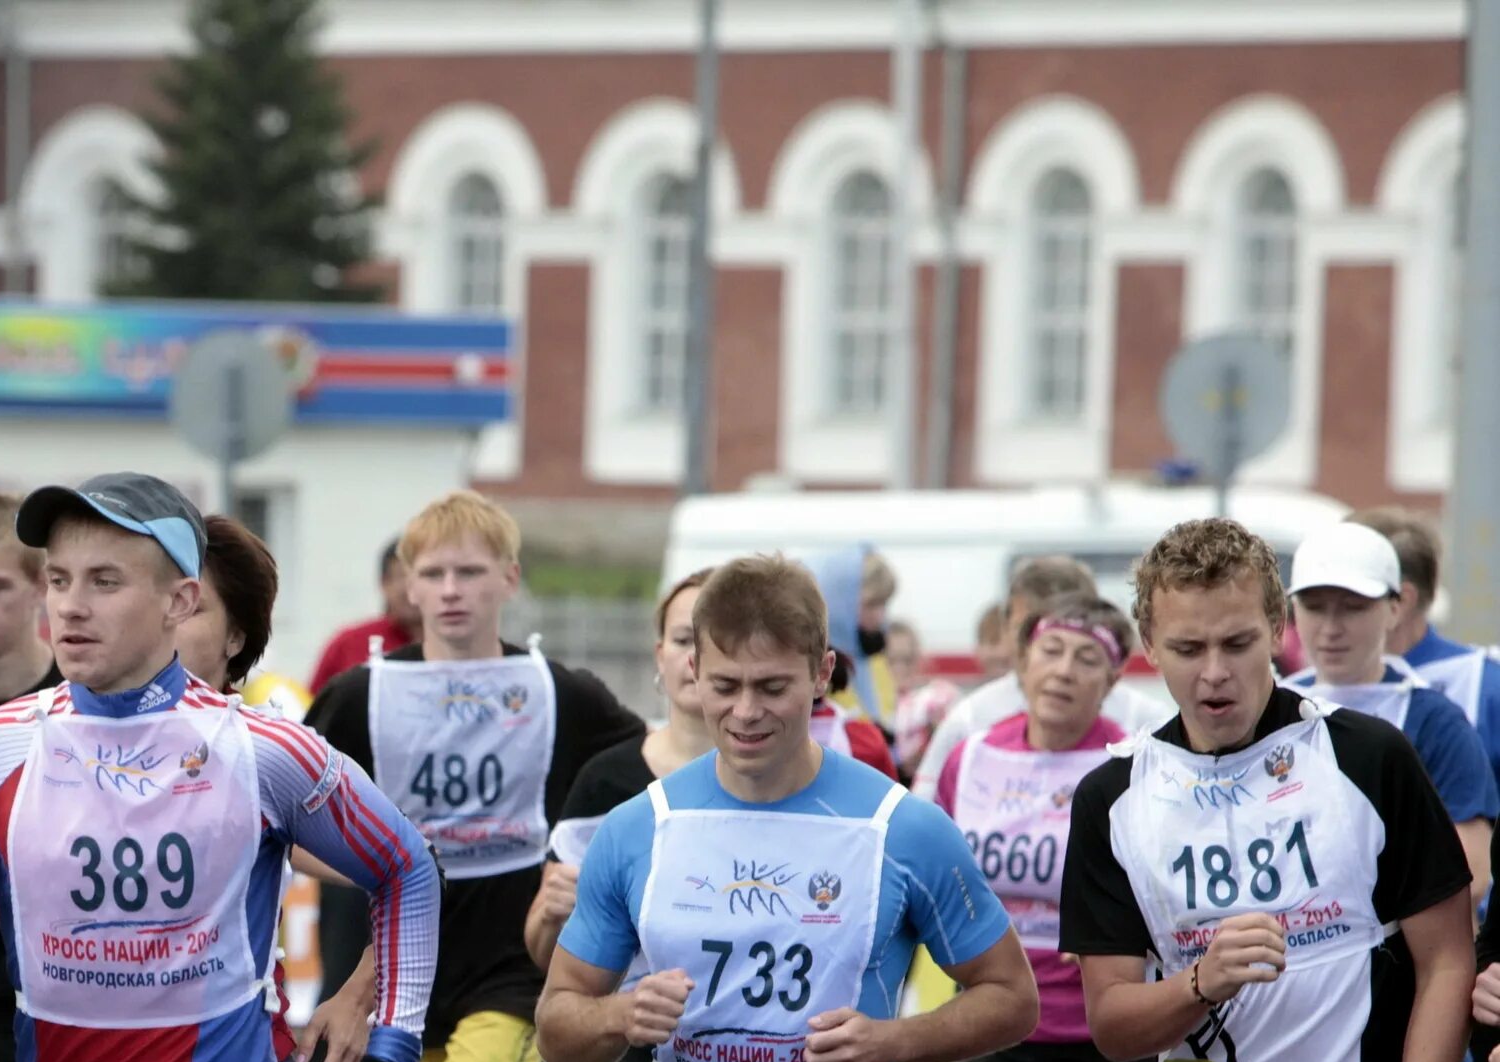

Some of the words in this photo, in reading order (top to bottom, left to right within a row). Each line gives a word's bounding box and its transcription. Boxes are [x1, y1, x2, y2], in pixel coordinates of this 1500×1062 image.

[137, 692, 171, 712] adidas
[410, 753, 503, 807] 480
[69, 832, 195, 912] 389
[1173, 820, 1319, 909] 1881
[1303, 901, 1342, 926] 2013
[42, 932, 97, 960] КРОСС
[103, 938, 170, 964] НАЦИИ
[1288, 923, 1351, 947] ОБЛАСТЬ
[42, 962, 155, 988] НОВГОРОДСКАЯ
[160, 956, 224, 986] ОБЛАСТЬ
[701, 939, 813, 1012] 733
